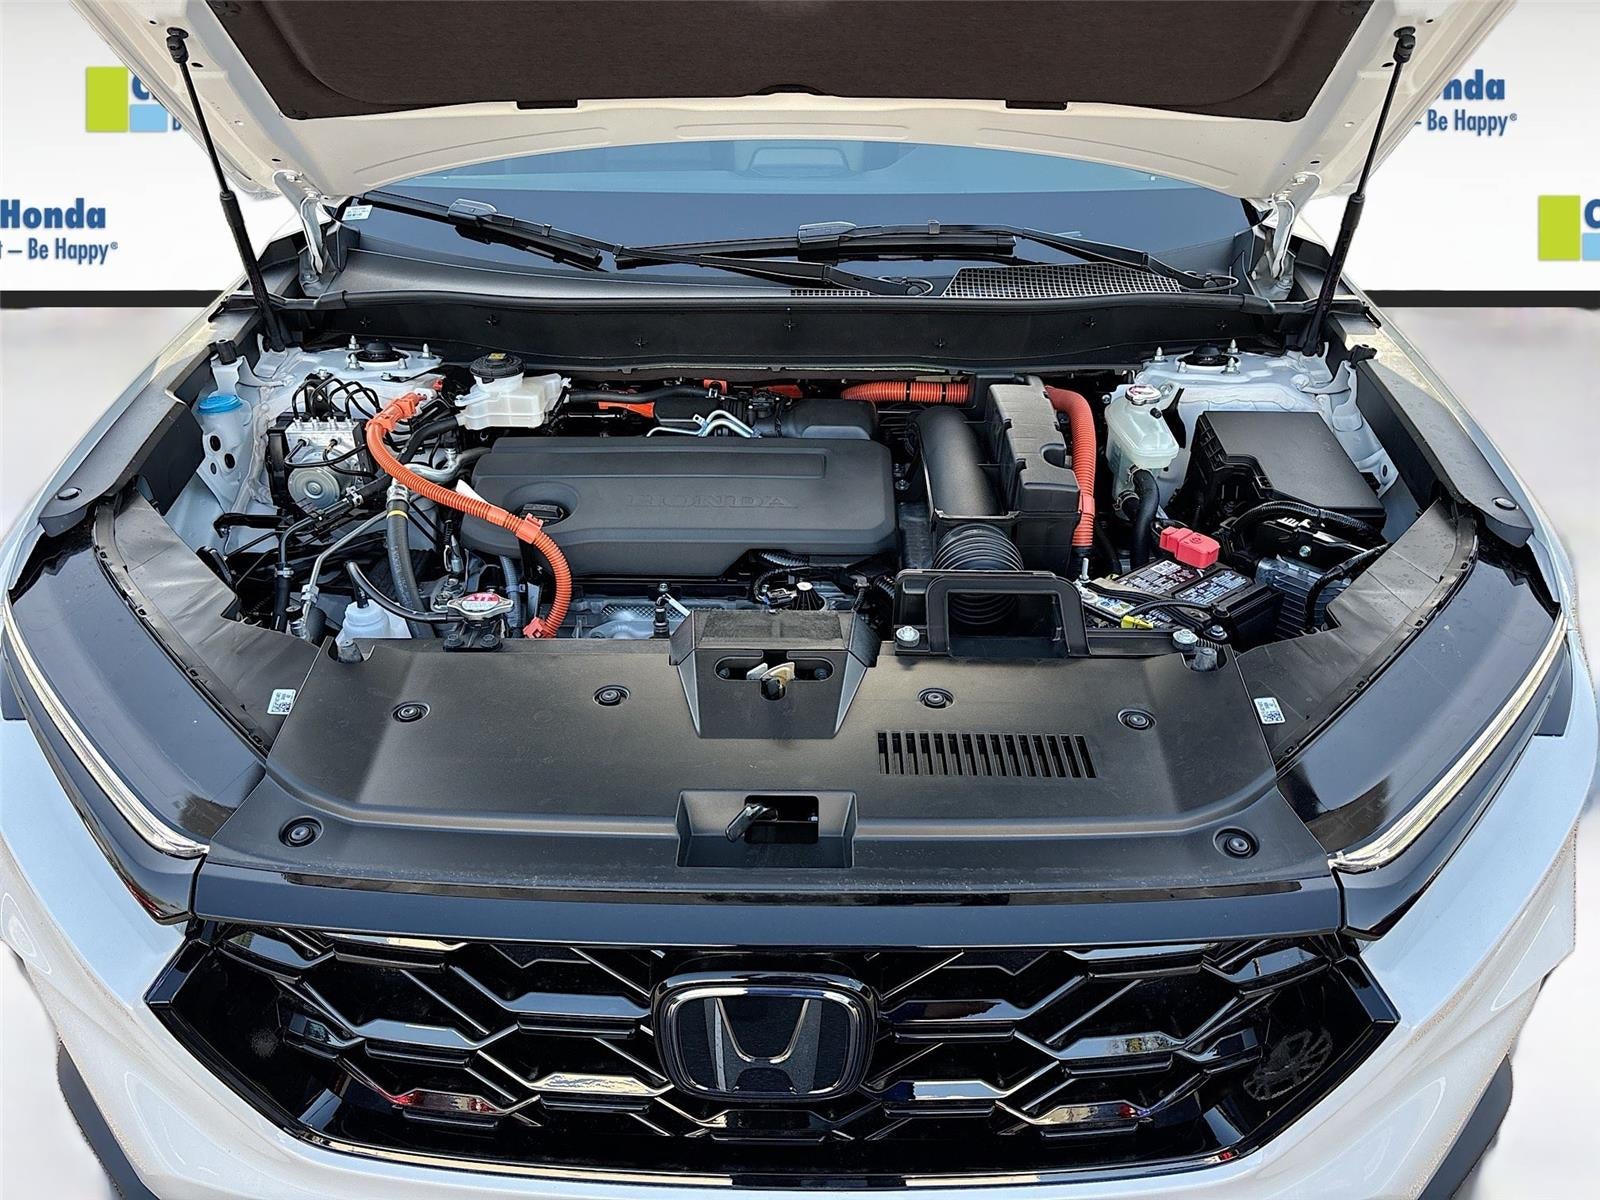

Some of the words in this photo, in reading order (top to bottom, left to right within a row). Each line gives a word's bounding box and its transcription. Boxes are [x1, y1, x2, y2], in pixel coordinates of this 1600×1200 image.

[1442, 69, 1506, 101] nda
[1427, 108, 1448, 131] Be
[0, 197, 106, 229] Honda
[28, 238, 49, 260] Be
[625, 494, 799, 509] HONDA
